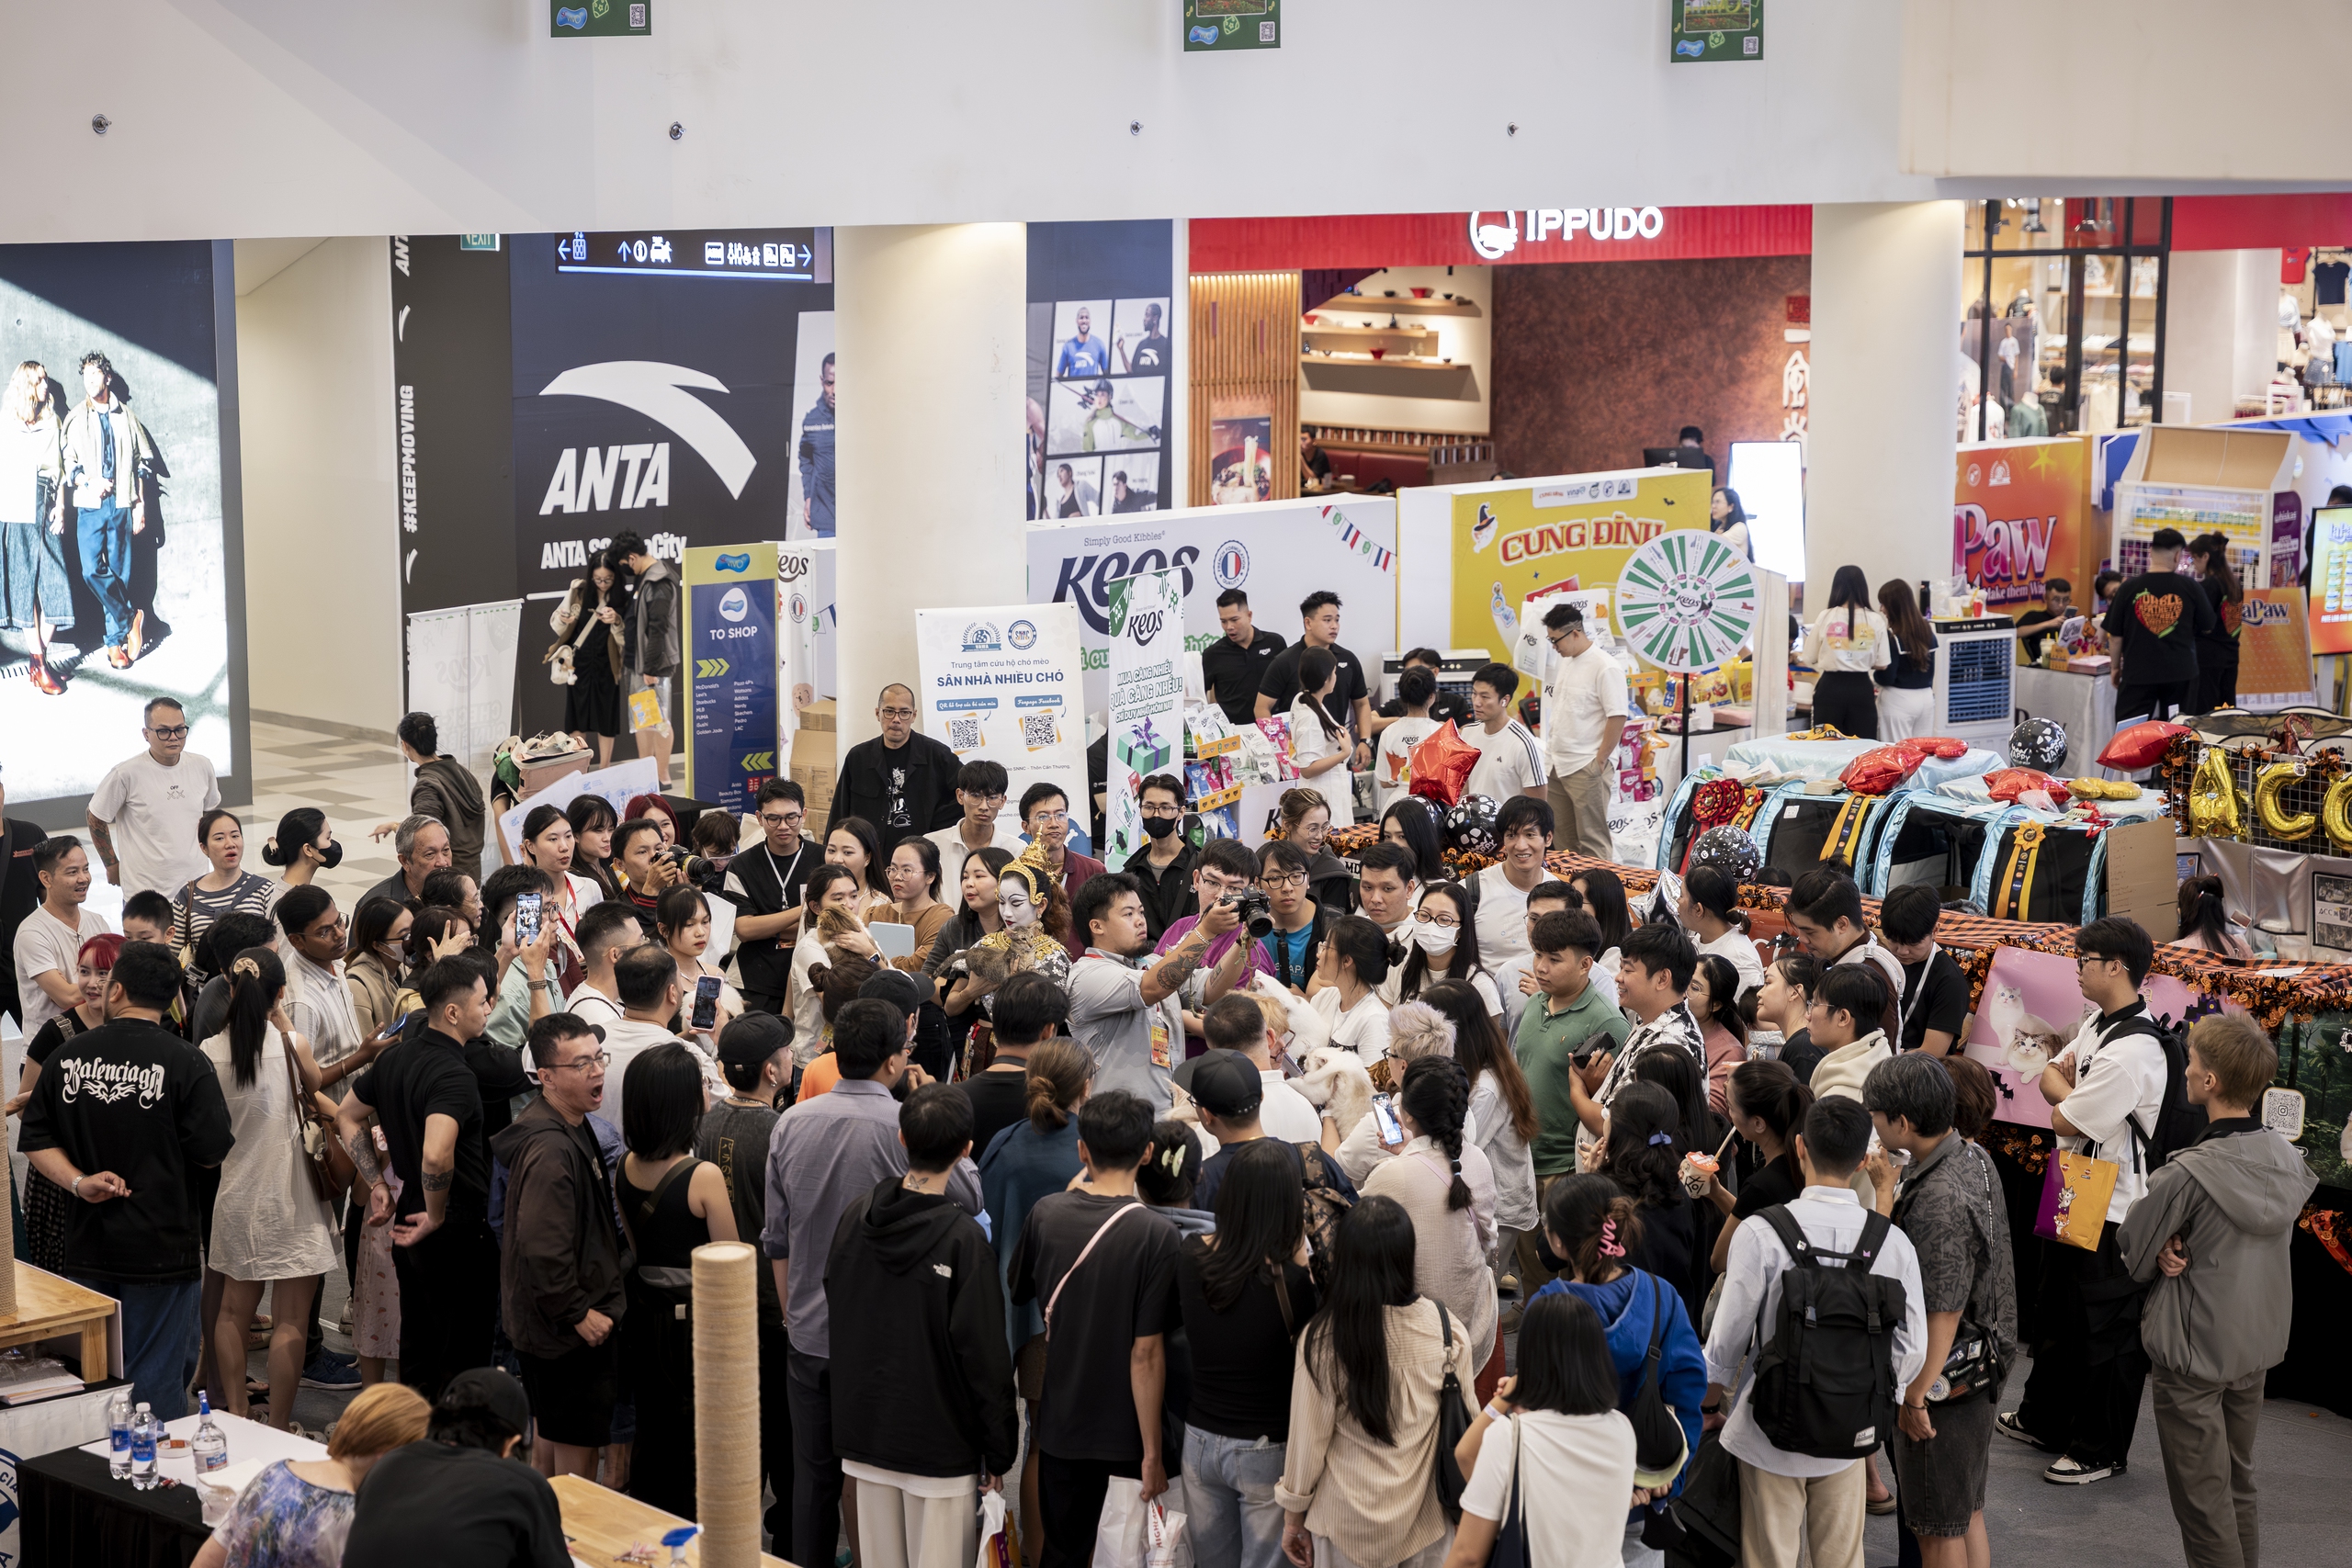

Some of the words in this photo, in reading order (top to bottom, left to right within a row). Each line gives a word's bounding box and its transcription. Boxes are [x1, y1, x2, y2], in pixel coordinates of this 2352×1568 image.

[1525, 206, 1664, 242] IPPUDO
[471, 234, 491, 246] EXIT
[400, 385, 418, 534] #KEEPMOVING
[539, 443, 670, 515] ANTA
[1084, 536, 1111, 547] Simply
[1112, 534, 1133, 546] Good
[1500, 523, 1587, 564] CUNG
[540, 540, 587, 570] ANTA
[778, 554, 808, 579] eos
[2242, 599, 2290, 626] aPaw
[709, 628, 725, 640] TO
[728, 626, 758, 638] SHOP
[951, 661, 972, 670] Trung
[974, 660, 989, 668] tâm
[990, 659, 1004, 667] cứu
[1006, 659, 1015, 668] hộ
[1017, 658, 1032, 666] chó
[1117, 671, 1133, 686] MUA
[1133, 666, 1152, 682] CÀNG
[937, 673, 963, 687] SÂN
[965, 672, 992, 686] NHÀ
[995, 671, 1033, 684] NHIỀU
[1035, 669, 1064, 682] CHÓ
[1110, 687, 1126, 711] QUÀ
[1127, 683, 1154, 704] CÀNG
[1162, 699, 1173, 713] NAY
